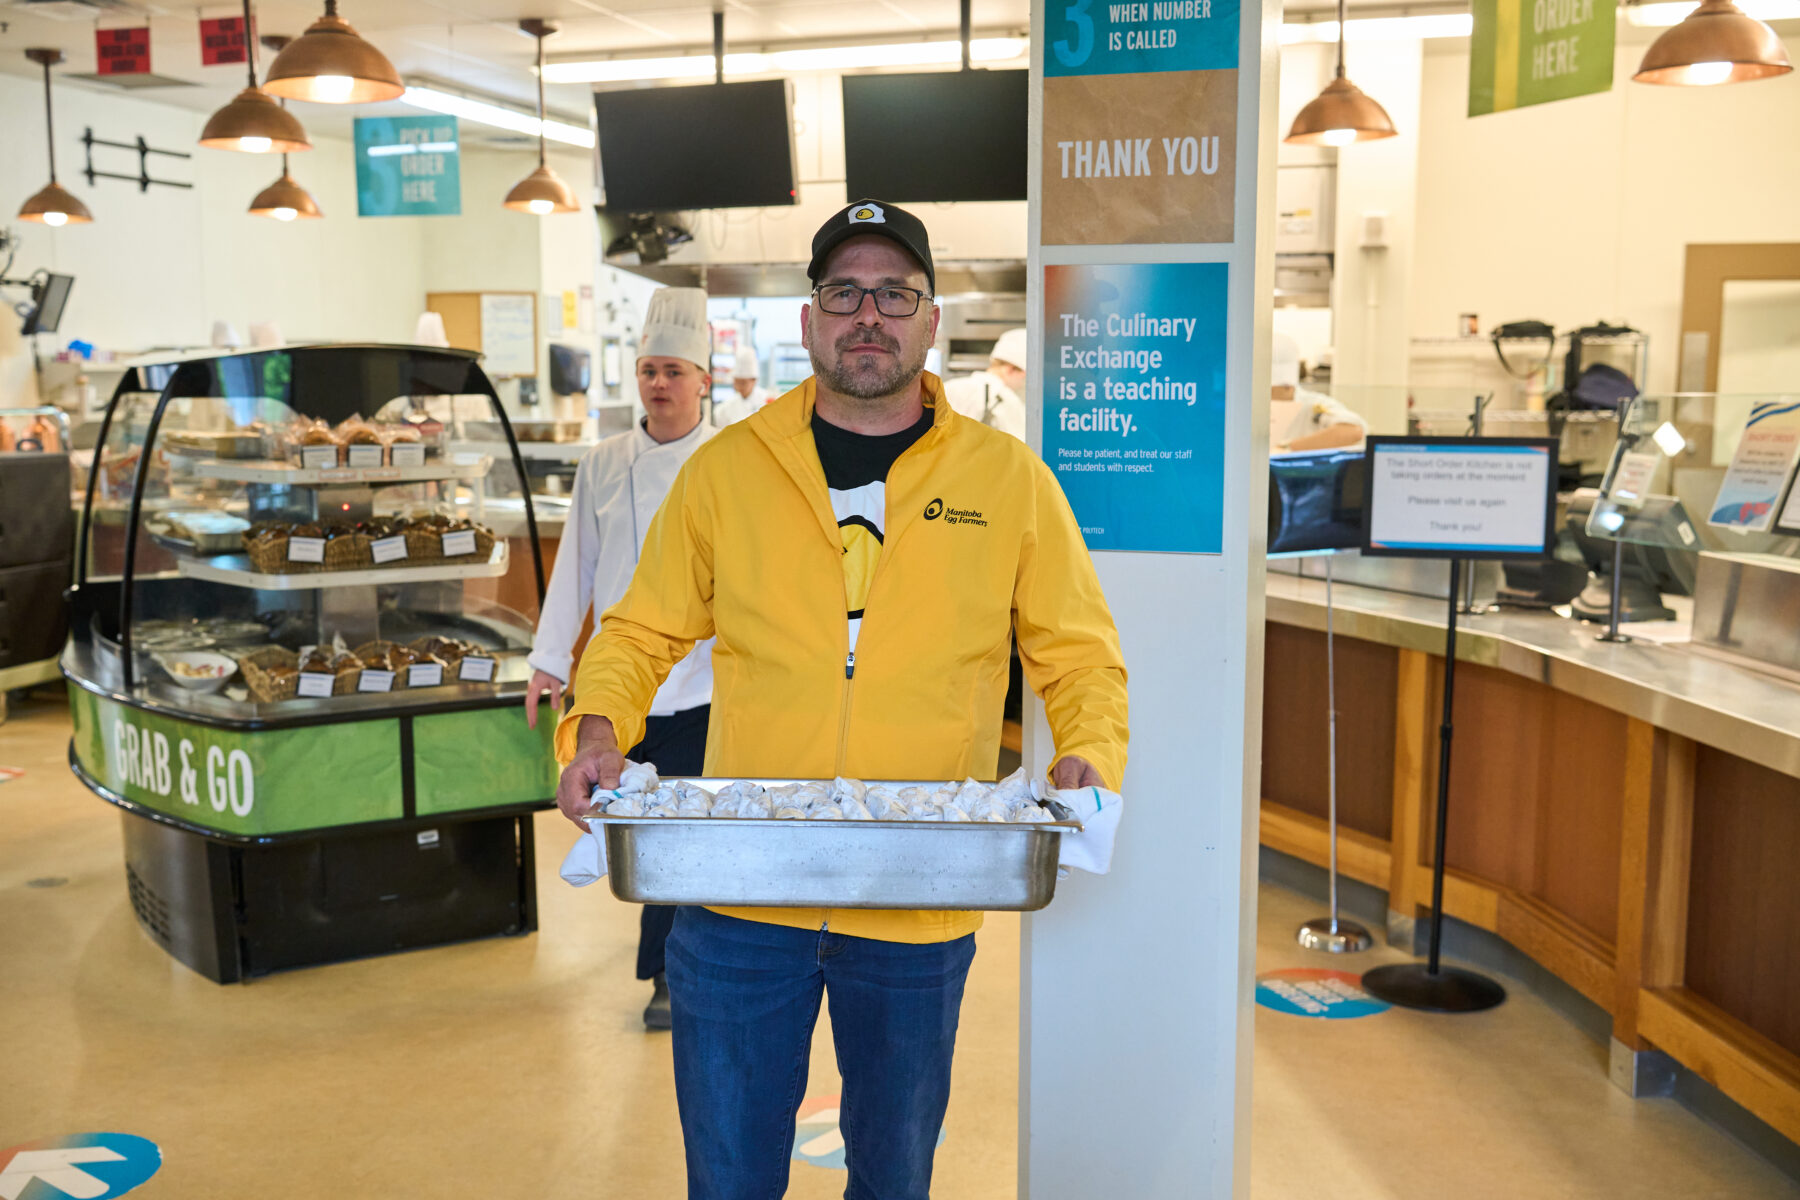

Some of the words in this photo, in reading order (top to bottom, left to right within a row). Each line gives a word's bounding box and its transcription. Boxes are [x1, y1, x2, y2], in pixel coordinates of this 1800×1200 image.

[1109, 3, 1149, 23] WHEN
[1153, 0, 1212, 21] NUMBER
[1533, 0, 1594, 34] ORDER
[1109, 32, 1122, 51] IS
[1127, 29, 1177, 49] CALLED
[1532, 36, 1580, 80] HERE
[401, 153, 445, 176] ORDER
[1057, 138, 1153, 178] THANK
[1162, 136, 1219, 176] YOU
[402, 180, 437, 203] HERE
[1060, 313, 1099, 337] The
[1106, 312, 1197, 342] Culinary
[1060, 345, 1163, 374] Exchange
[1060, 376, 1077, 400] is
[1083, 381, 1096, 400] a
[1103, 376, 1197, 406] teaching
[1059, 407, 1138, 437] facility.
[1058, 447, 1082, 458] Please
[1083, 448, 1093, 458] be
[1094, 448, 1122, 460] patient,
[1123, 449, 1138, 459] and
[1139, 449, 1158, 459] treat
[1159, 450, 1172, 459] our
[1174, 449, 1193, 459] staff
[1386, 458, 1404, 469] The
[1407, 458, 1433, 469] Short
[1435, 458, 1463, 469] Order
[1466, 459, 1502, 470] Kitchen
[1058, 461, 1073, 471] and
[1073, 461, 1106, 472] students
[1106, 462, 1123, 472] with
[1124, 463, 1154, 474] respect.
[1390, 471, 1420, 482] taking
[1422, 471, 1453, 481] orders
[1467, 471, 1484, 481] the
[1407, 496, 1440, 505] Please
[944, 515, 957, 524] Egg
[958, 516, 987, 527] Farmers
[946, 508, 982, 518] Manitoba
[1082, 527, 1104, 535] POLYTECH
[1430, 521, 1458, 531] Thank
[114, 719, 172, 796] GRAB
[179, 738, 199, 806] &
[207, 744, 254, 818] GO
